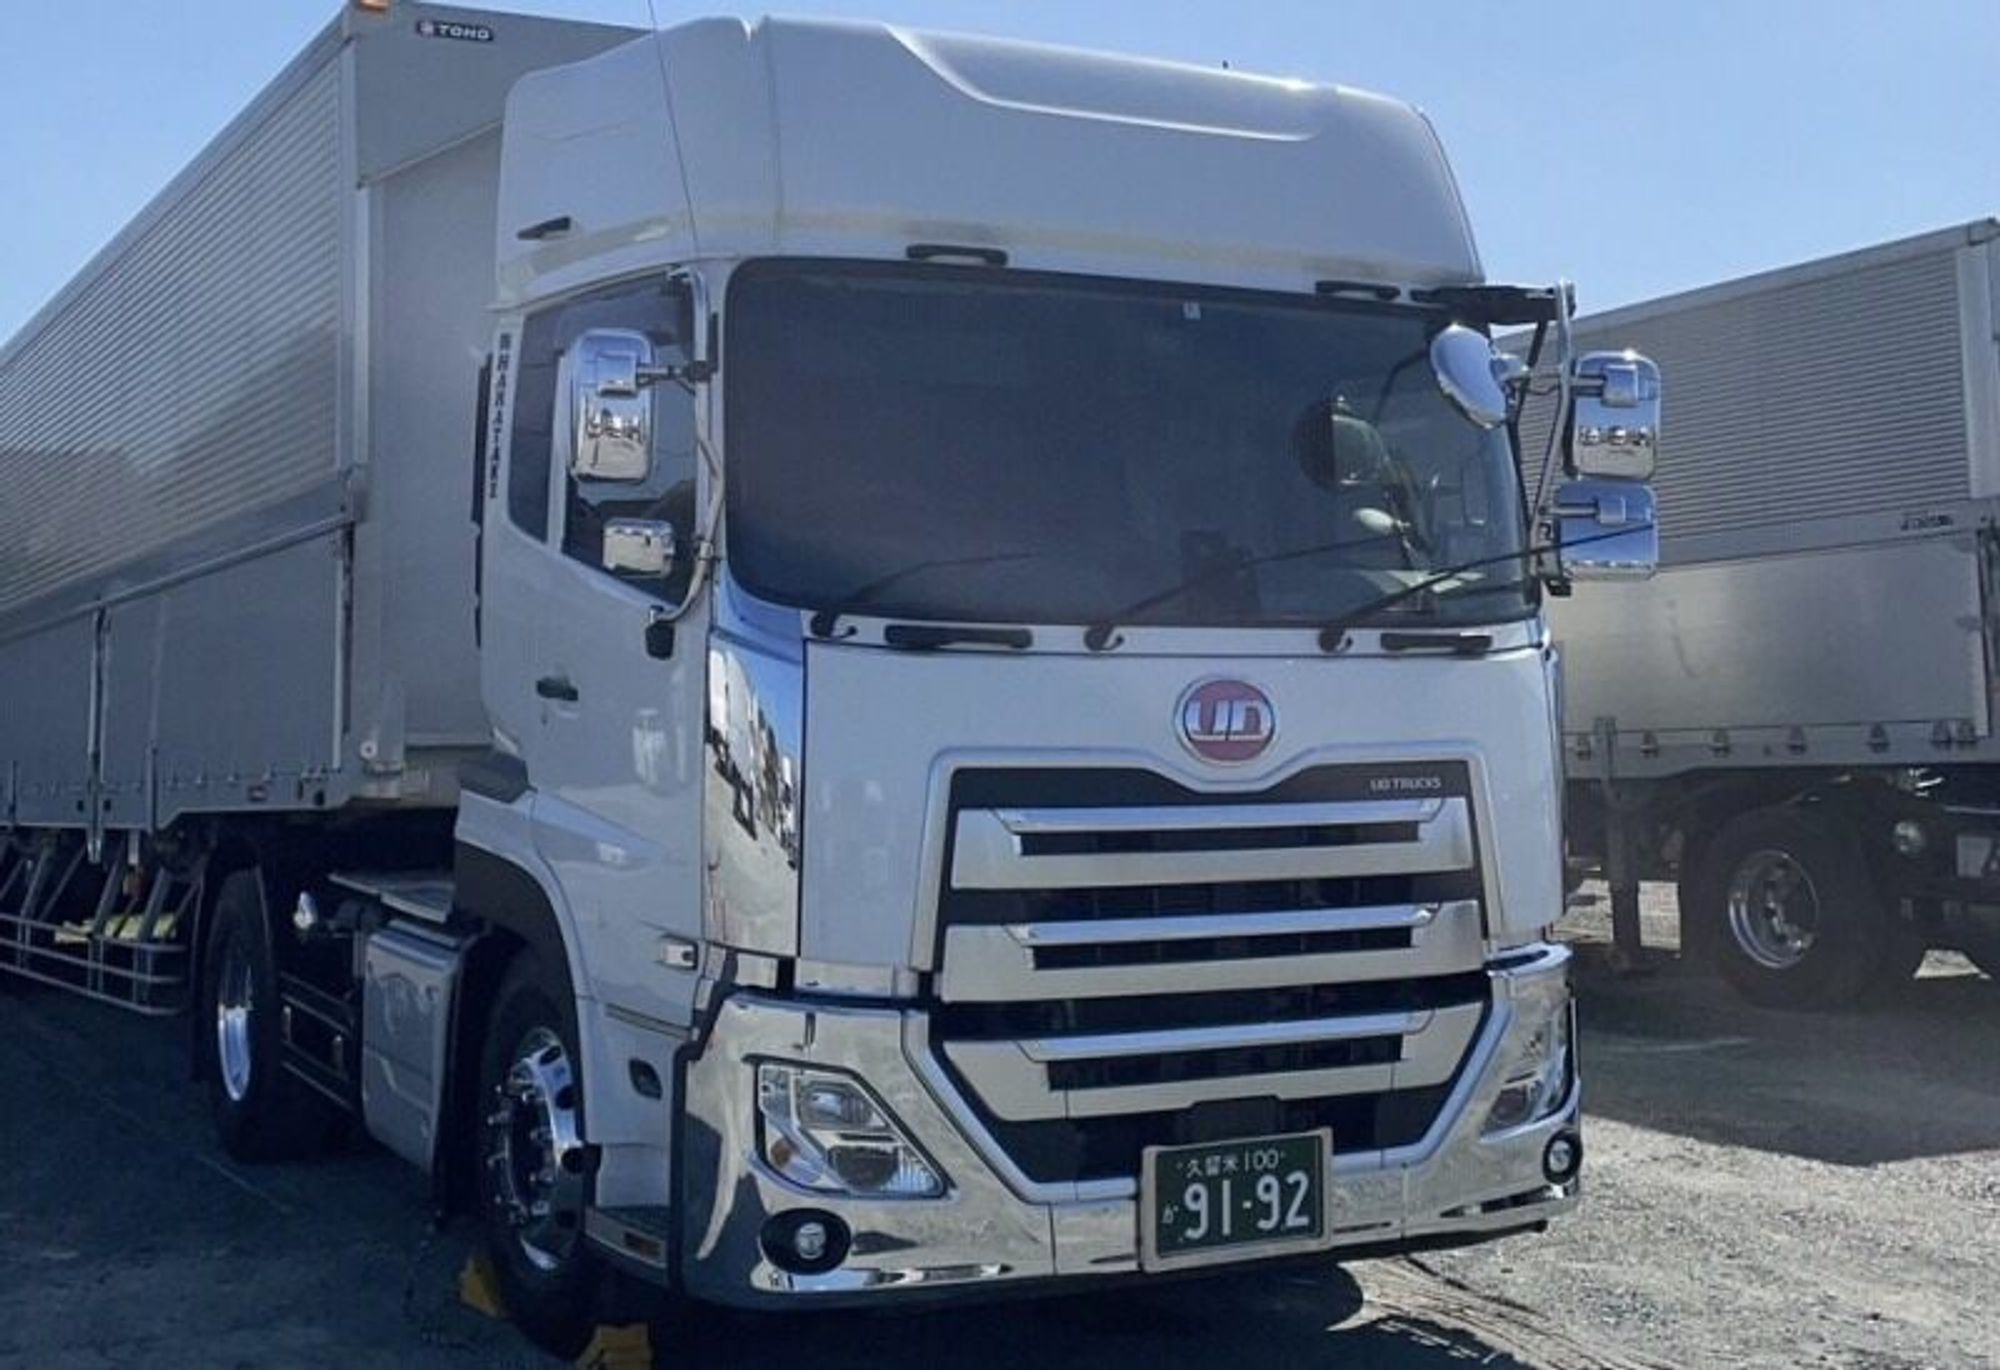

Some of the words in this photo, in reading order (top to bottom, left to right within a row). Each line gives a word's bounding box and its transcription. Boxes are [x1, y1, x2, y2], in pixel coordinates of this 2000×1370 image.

[1184, 698, 1273, 742] UD
[1369, 778, 1391, 791] UD
[1393, 776, 1442, 790] TRUCKS
[1186, 1155, 1239, 1179] 久留米
[1244, 1149, 1280, 1172] 100
[1183, 1171, 1309, 1239] 91-92
